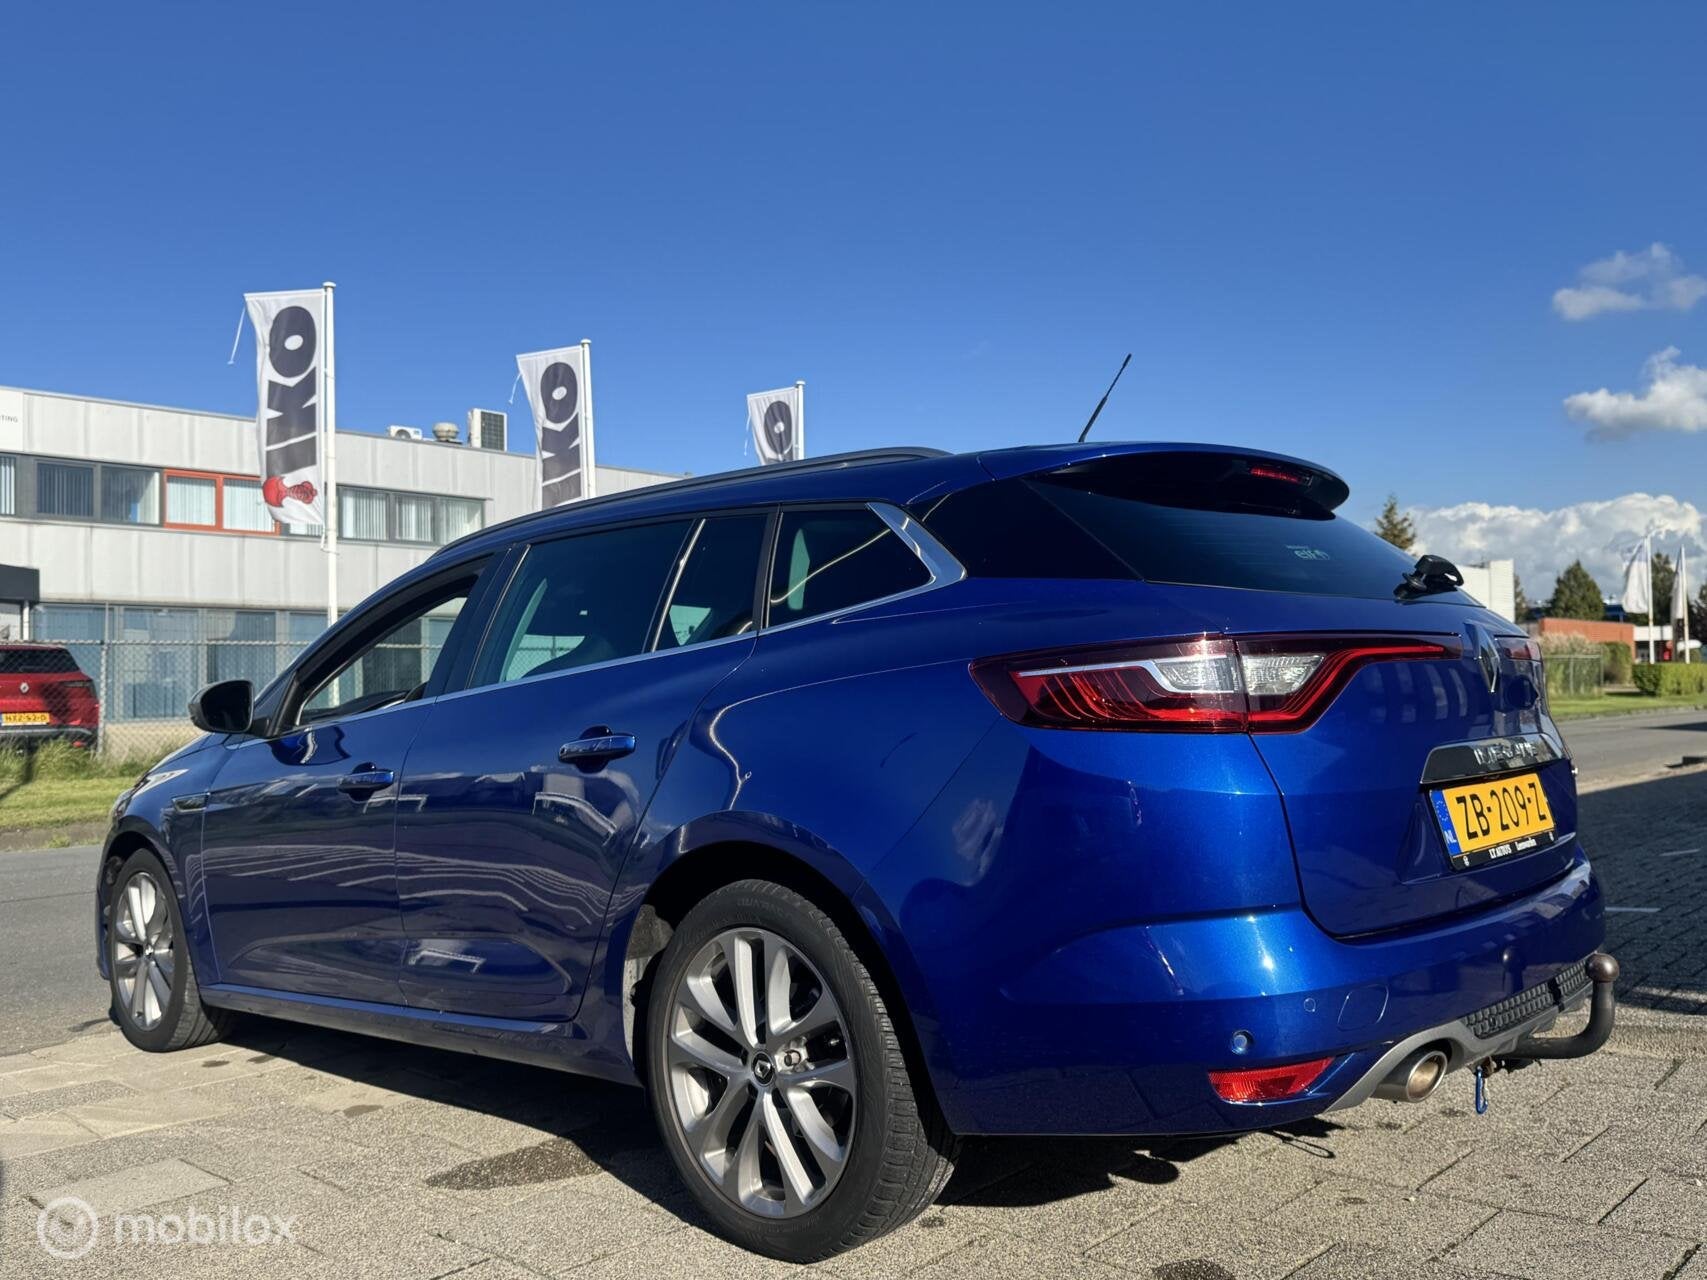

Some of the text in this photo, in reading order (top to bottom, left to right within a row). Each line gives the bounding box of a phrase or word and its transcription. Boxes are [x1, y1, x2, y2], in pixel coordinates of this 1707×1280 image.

[265, 305, 317, 479] IKO
[0, 414, 19, 423] TING
[1456, 782, 1547, 840] ZB-209-Z
[1444, 831, 1457, 844] NL
